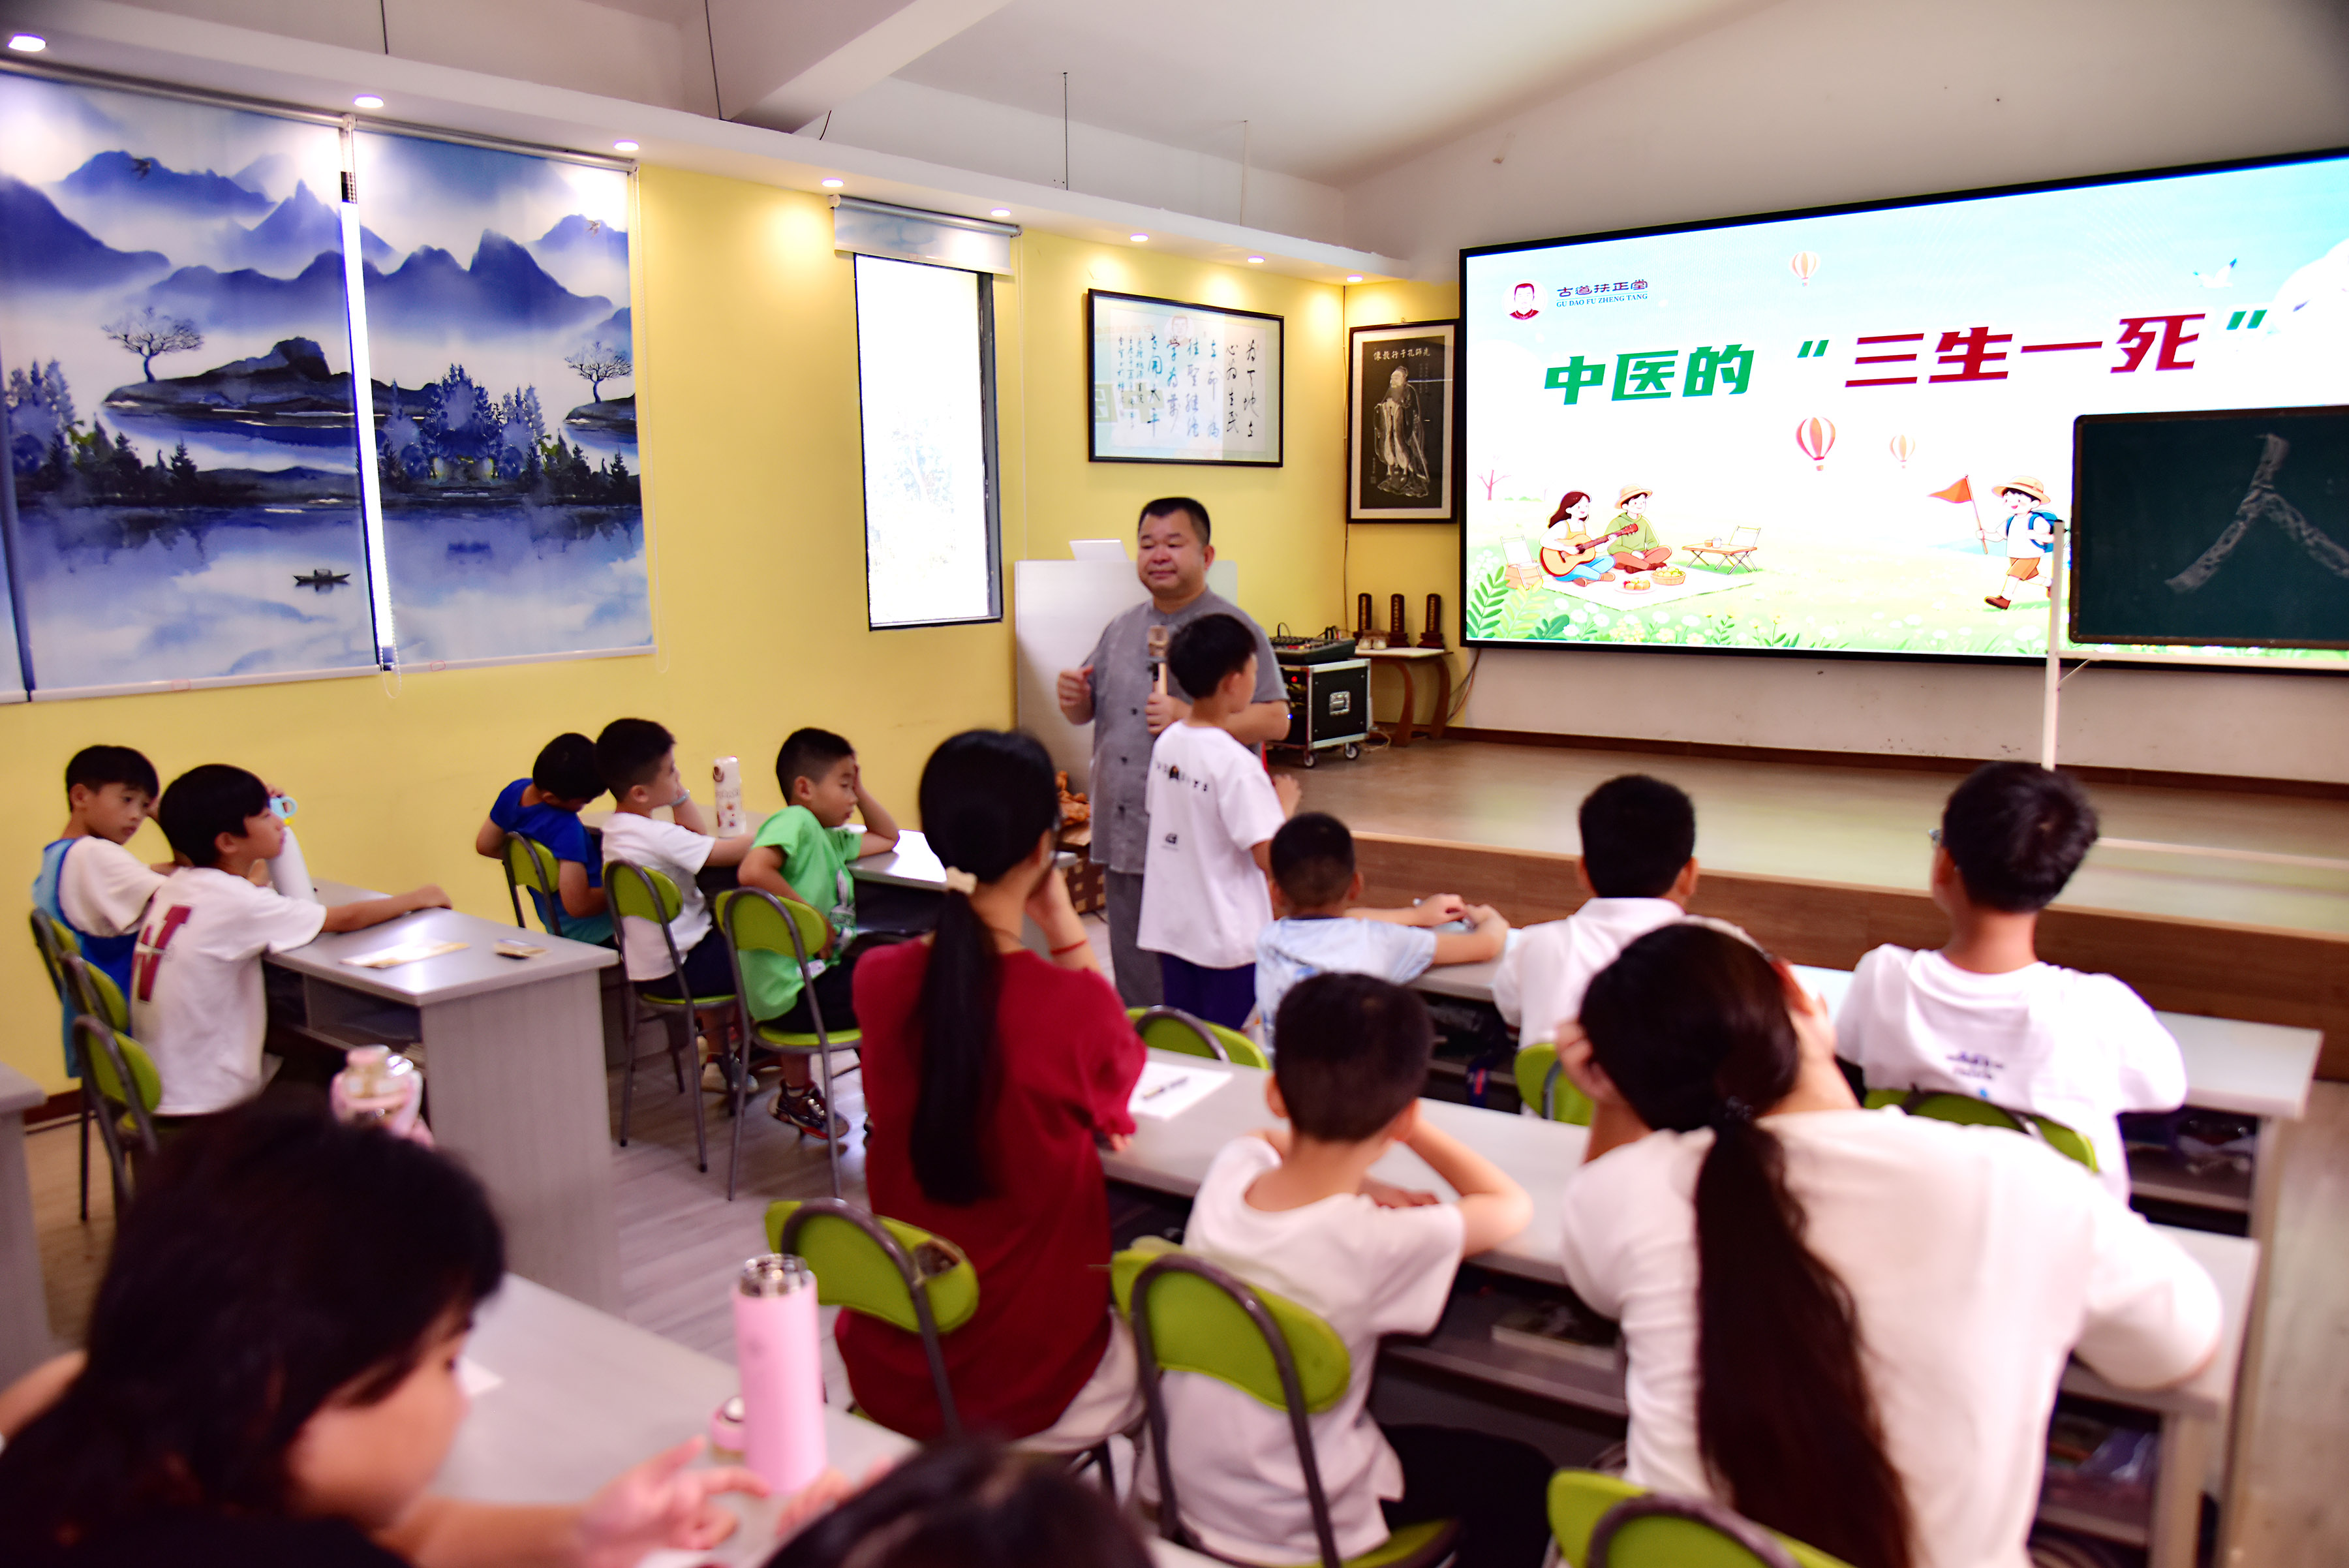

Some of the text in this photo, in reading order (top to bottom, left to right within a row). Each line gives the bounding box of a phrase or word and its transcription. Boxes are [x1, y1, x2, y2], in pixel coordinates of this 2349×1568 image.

[1557, 279, 1648, 298] 古道扶正堂
[2165, 432, 2349, 592] 人
